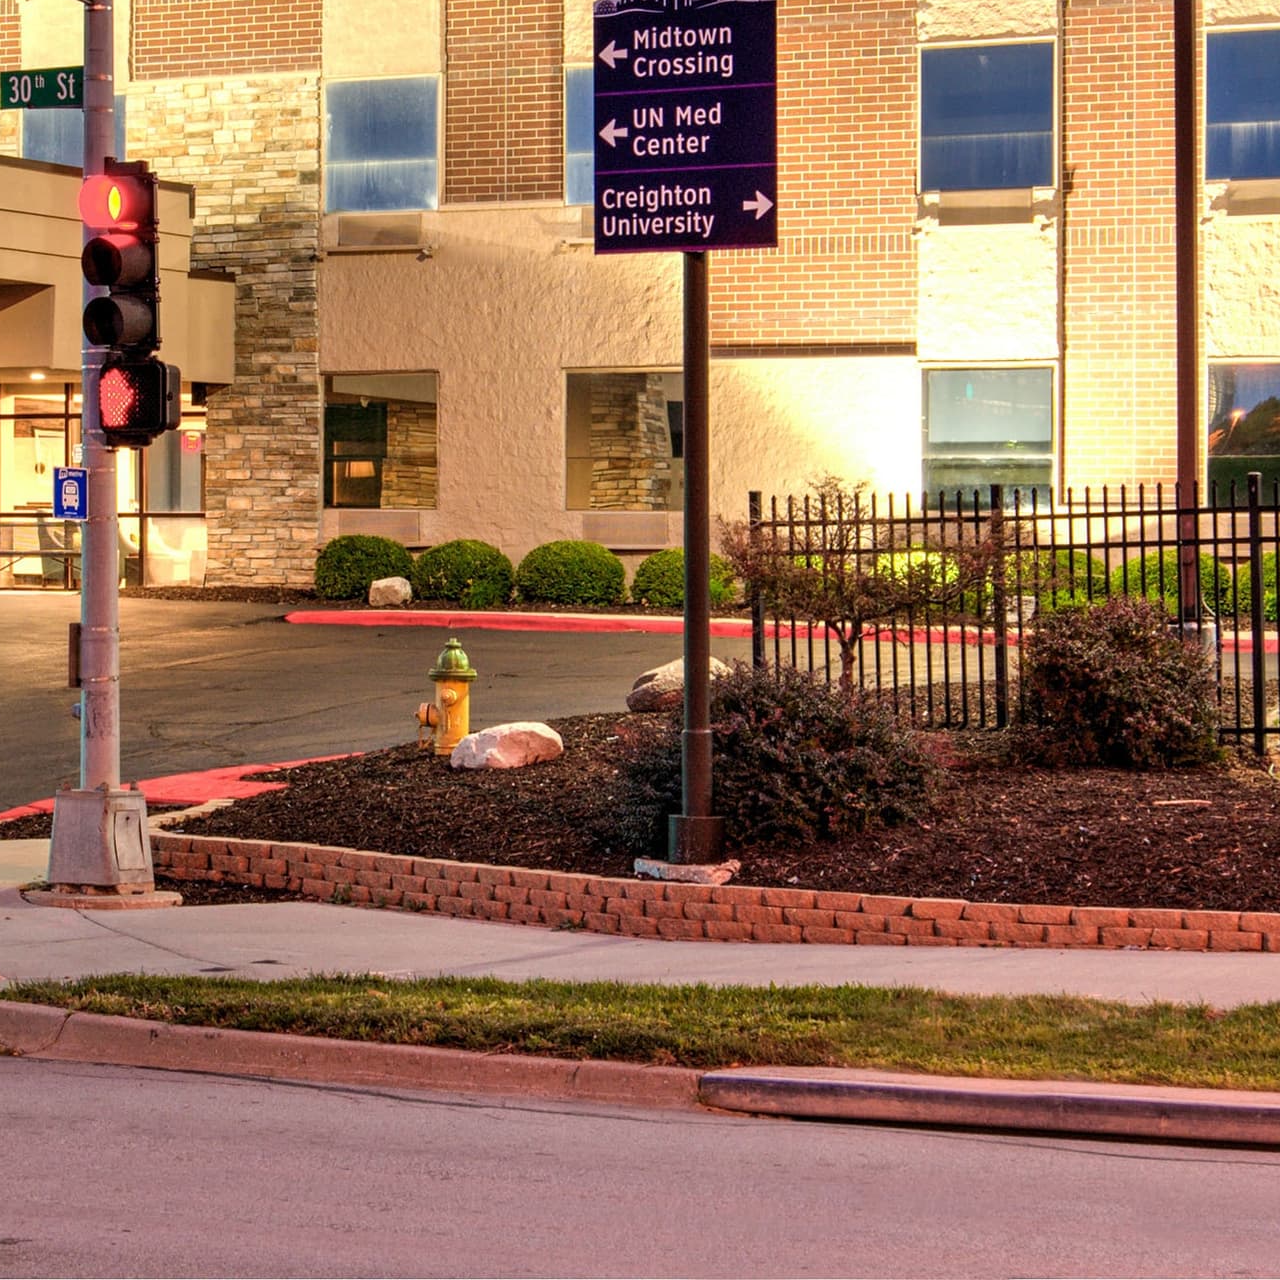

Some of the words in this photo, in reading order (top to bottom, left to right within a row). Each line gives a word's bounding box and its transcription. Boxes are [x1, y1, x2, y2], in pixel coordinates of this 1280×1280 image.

[633, 26, 732, 50] Midtown
[633, 53, 734, 78] Crossing
[8, 74, 45, 103] 30th
[56, 71, 76, 100] St
[633, 107, 664, 129] UN
[675, 103, 721, 126] Med
[633, 135, 710, 157] Center
[602, 185, 712, 212] Creighton
[602, 211, 715, 238] University
